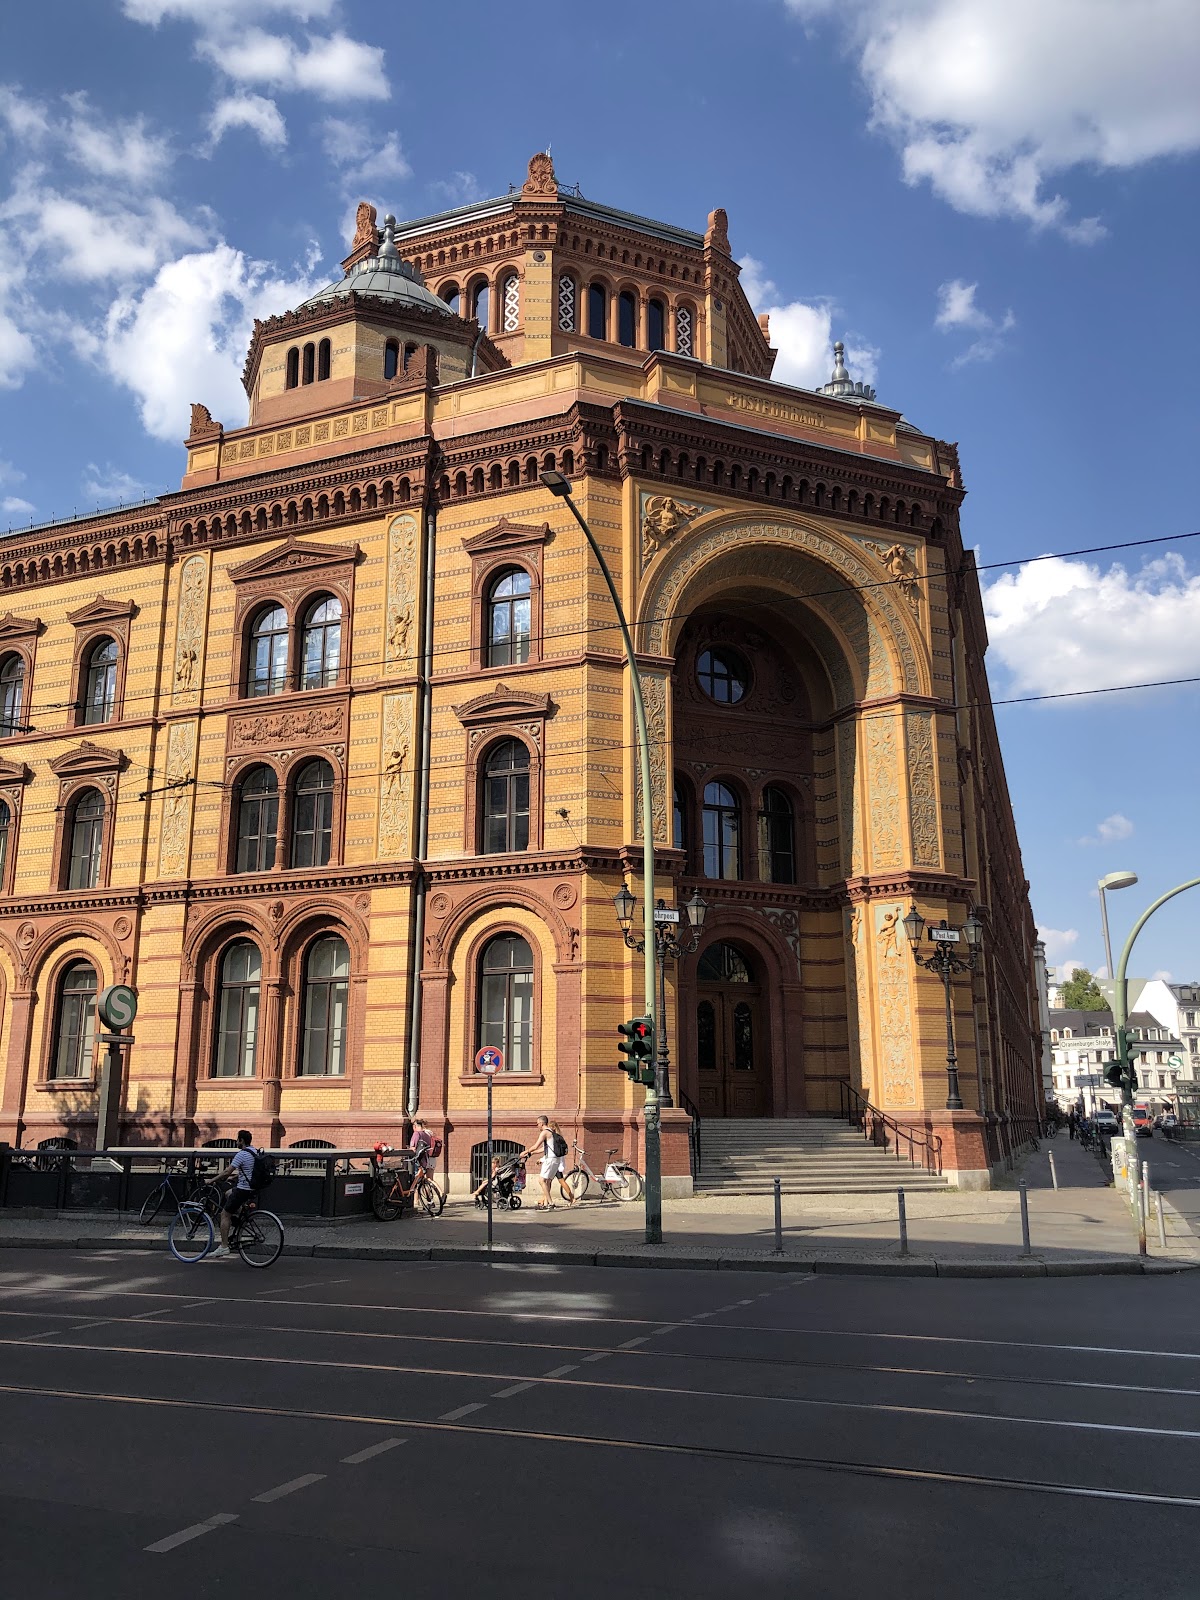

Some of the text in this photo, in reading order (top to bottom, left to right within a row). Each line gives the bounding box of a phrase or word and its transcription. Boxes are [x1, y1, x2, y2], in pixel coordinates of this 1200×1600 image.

[726, 391, 826, 428] POSTFUHRAMT
[654, 910, 675, 920] ohrpost
[935, 930, 945, 939] Post
[110, 988, 132, 1026] S
[1061, 1040, 1095, 1048] Oranienburger
[1168, 1055, 1181, 1069] S
